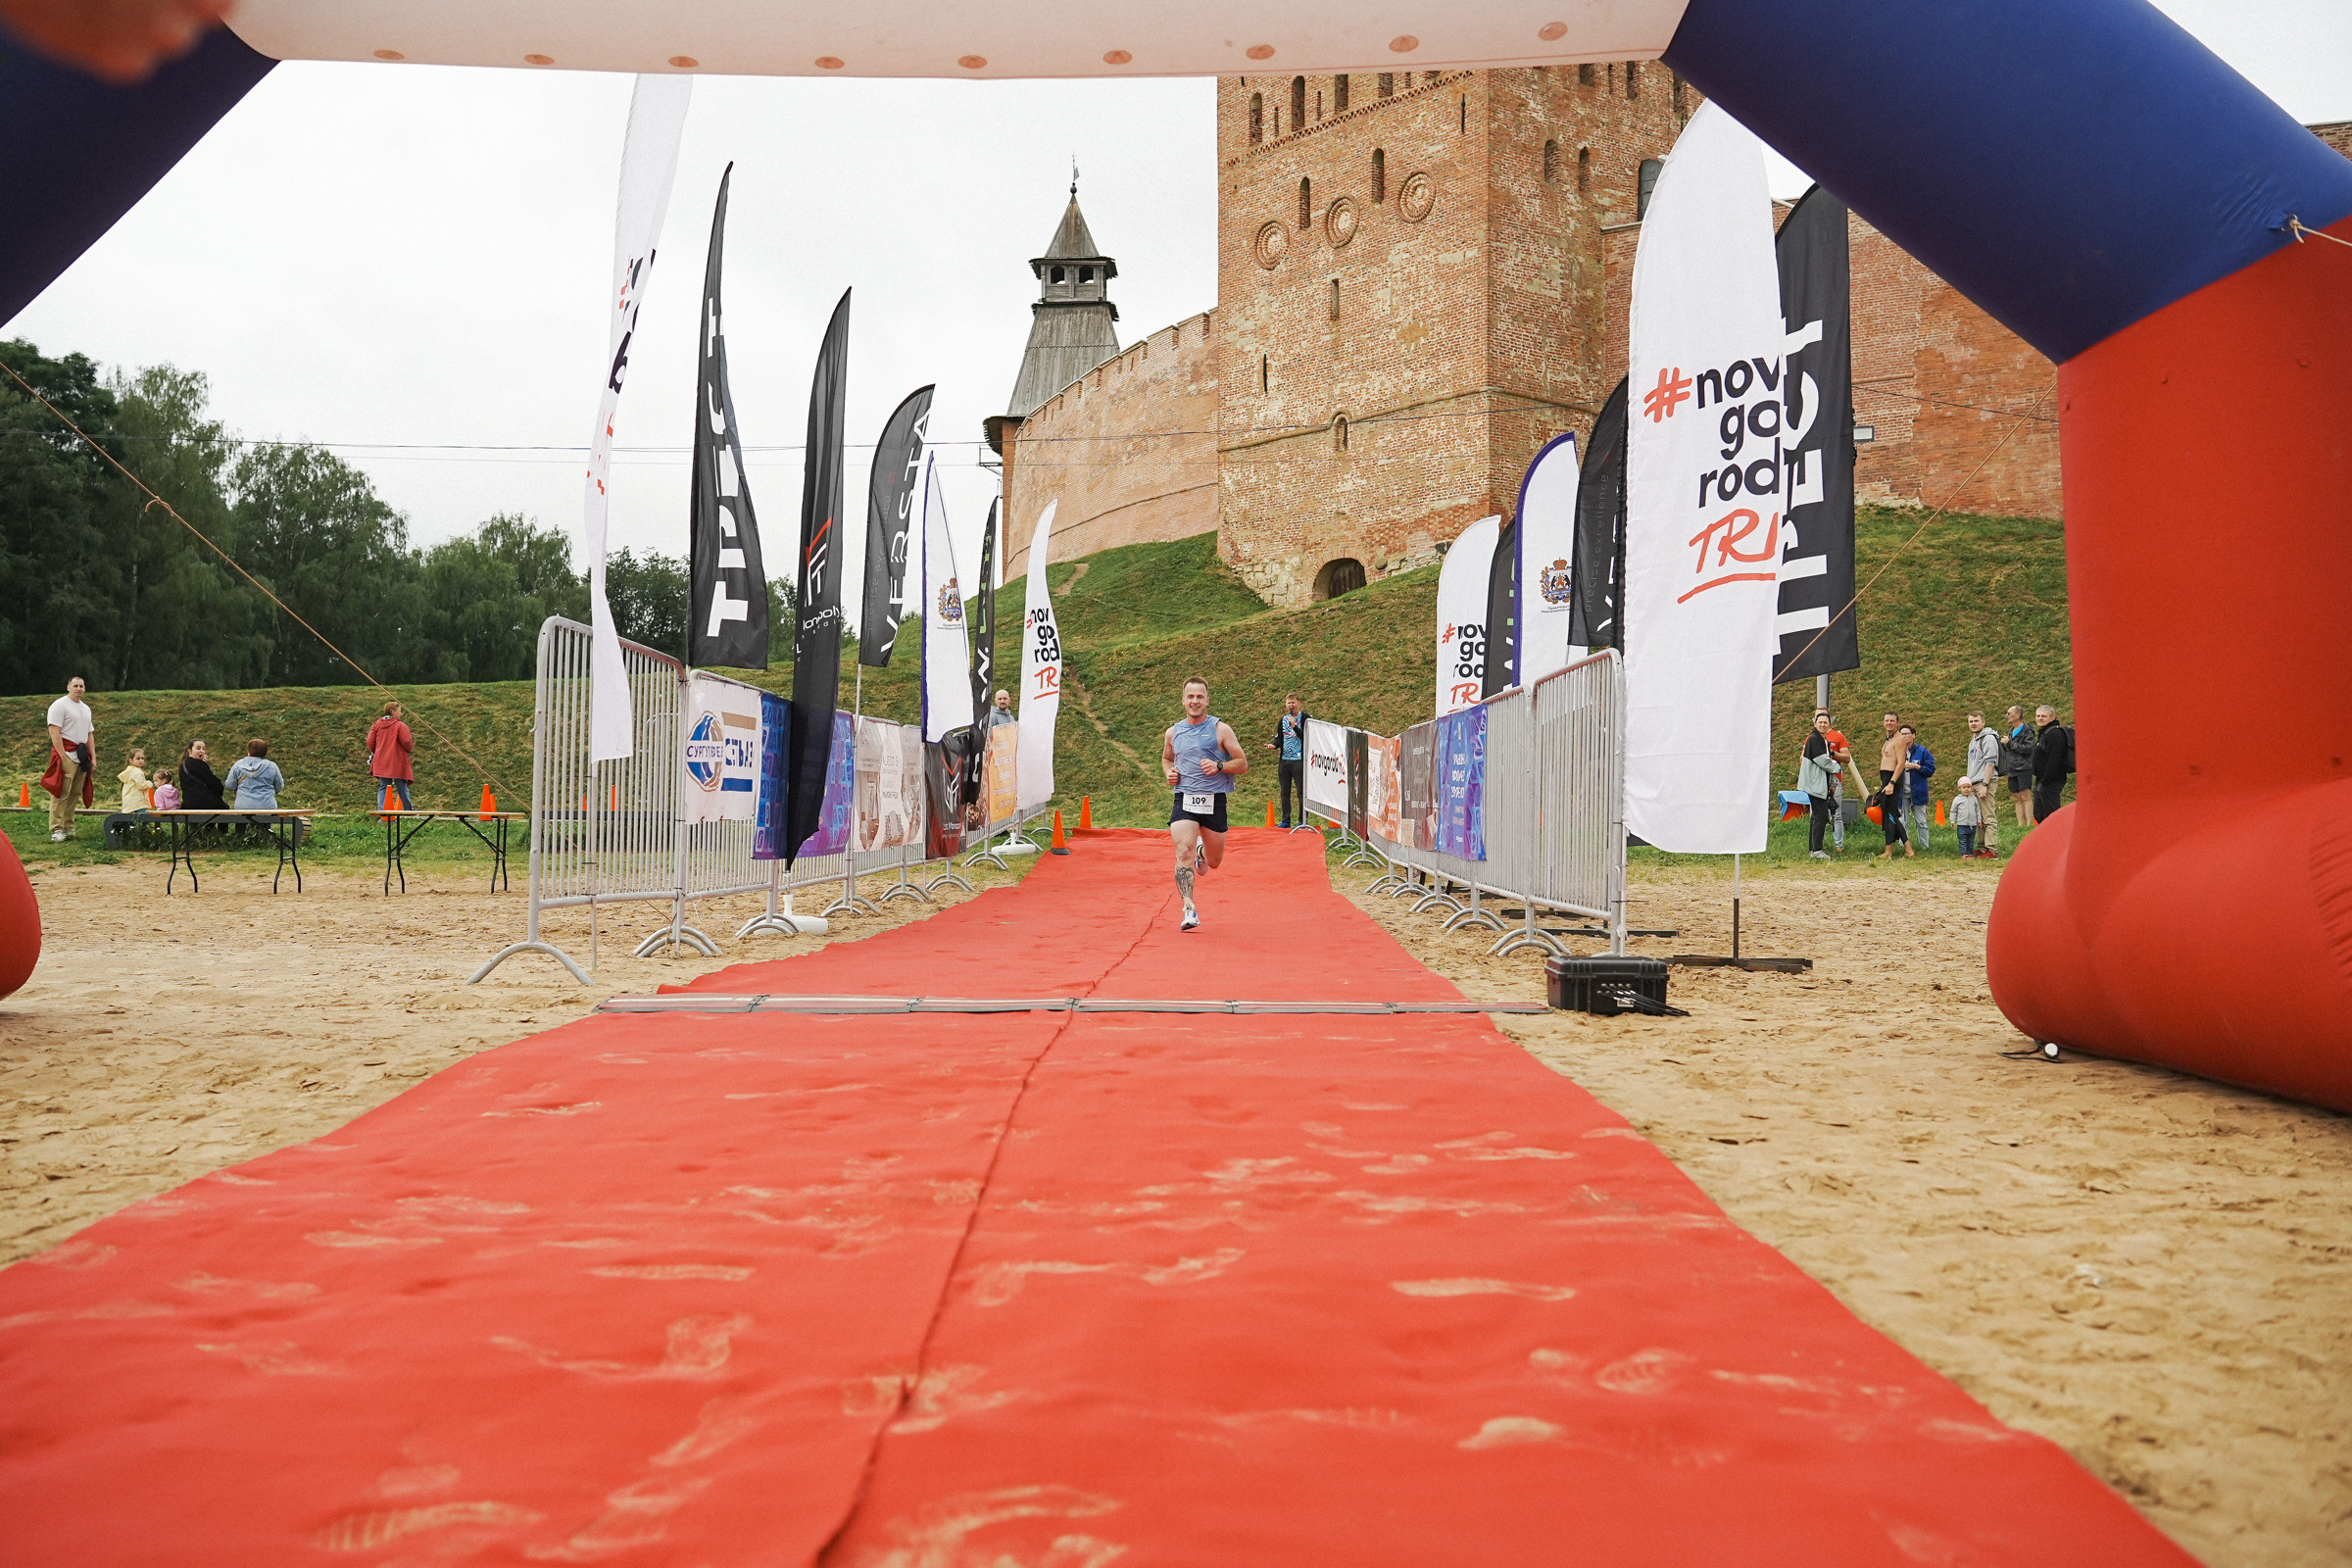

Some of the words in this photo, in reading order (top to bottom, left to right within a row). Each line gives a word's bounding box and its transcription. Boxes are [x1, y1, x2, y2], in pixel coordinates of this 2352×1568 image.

[1643, 355, 1780, 423] #nov
[1720, 400, 1780, 461] go
[1698, 436, 1780, 509] rod
[1775, 317, 1830, 656] ТРЕСТ
[1586, 560, 1599, 613] precise
[1593, 473, 1609, 554] excellence
[1689, 508, 1779, 574] TRI
[1034, 638, 1060, 663] rod
[1034, 665, 1058, 689] TR
[1450, 682, 1482, 705] TR
